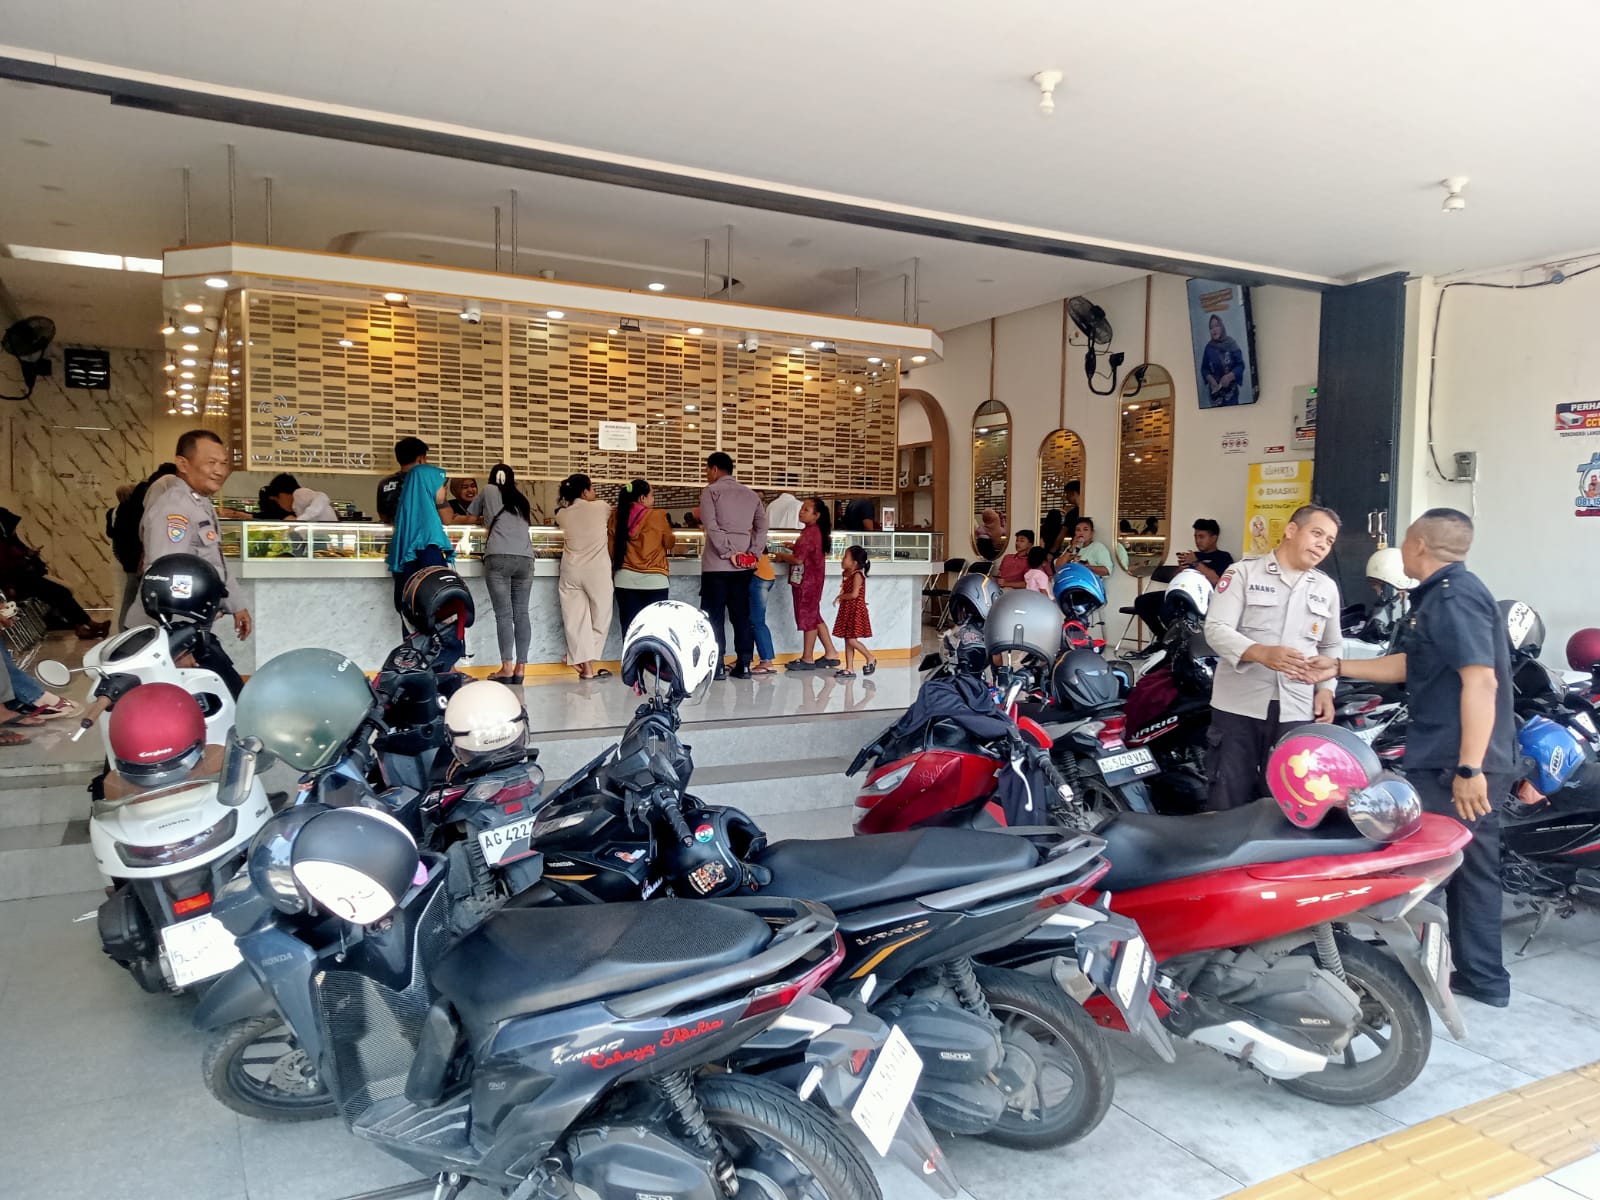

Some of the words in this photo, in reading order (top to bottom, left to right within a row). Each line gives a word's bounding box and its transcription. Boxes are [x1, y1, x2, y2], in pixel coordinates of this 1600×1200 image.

[1248, 584, 1276, 594] ANANG
[1131, 715, 1179, 740] VARIO
[484, 832, 503, 849] AG
[1295, 885, 1373, 907] PCX
[261, 952, 294, 967] HONDA
